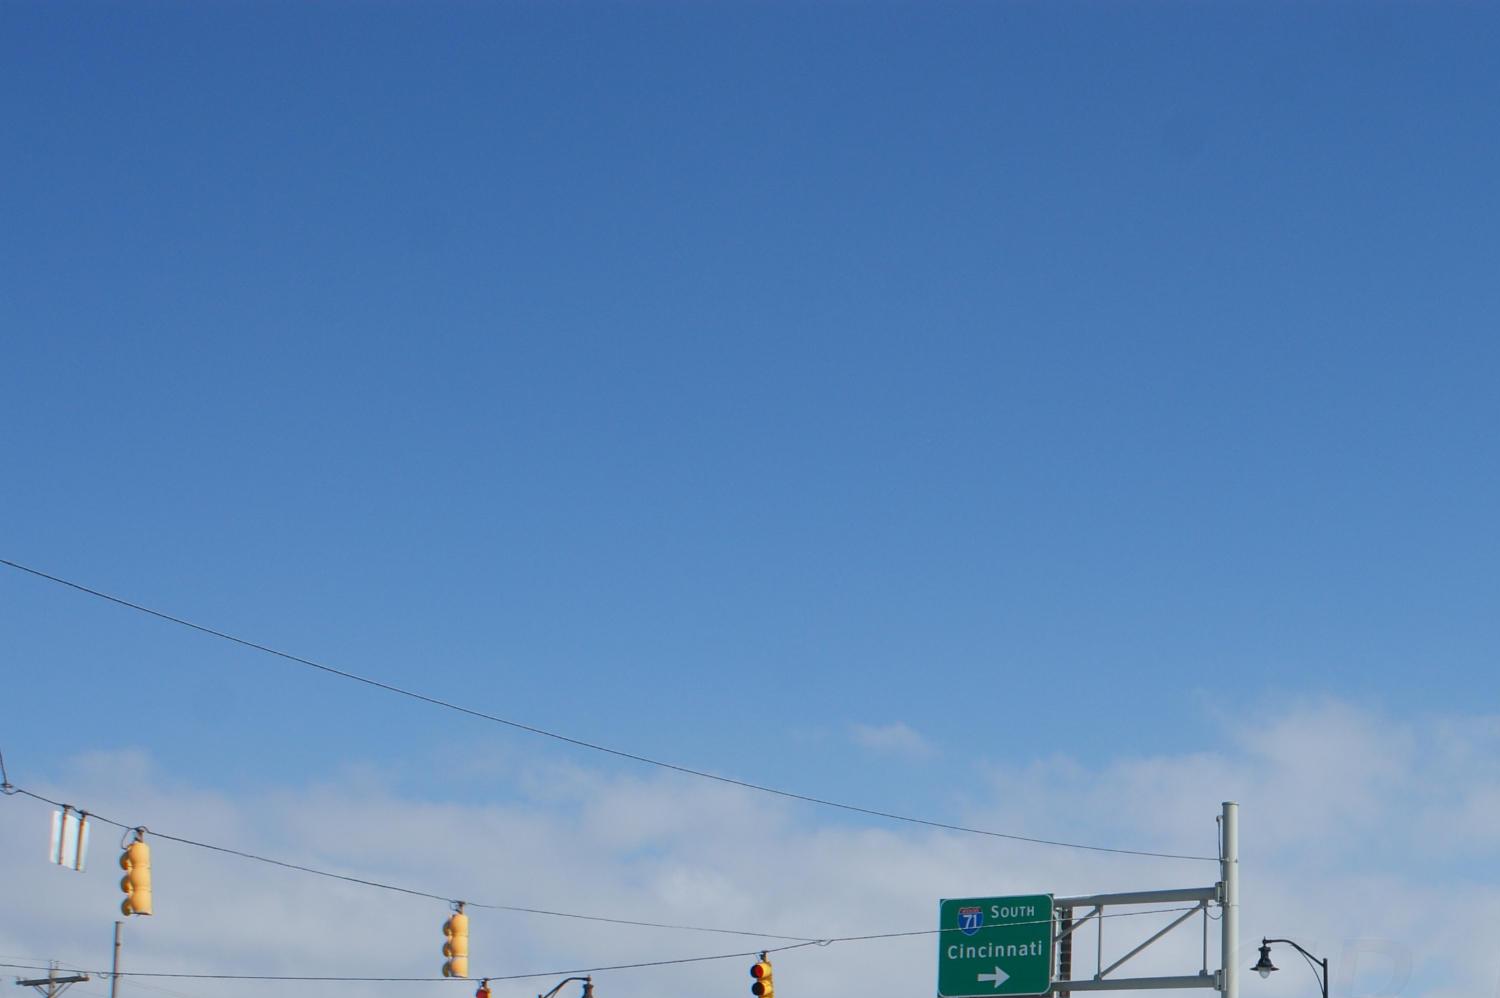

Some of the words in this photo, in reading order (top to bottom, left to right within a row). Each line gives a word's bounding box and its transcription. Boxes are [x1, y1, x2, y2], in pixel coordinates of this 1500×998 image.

[962, 914, 978, 929] 71
[991, 905, 1035, 918] SOUTH
[947, 940, 1042, 960] Cincinnati
